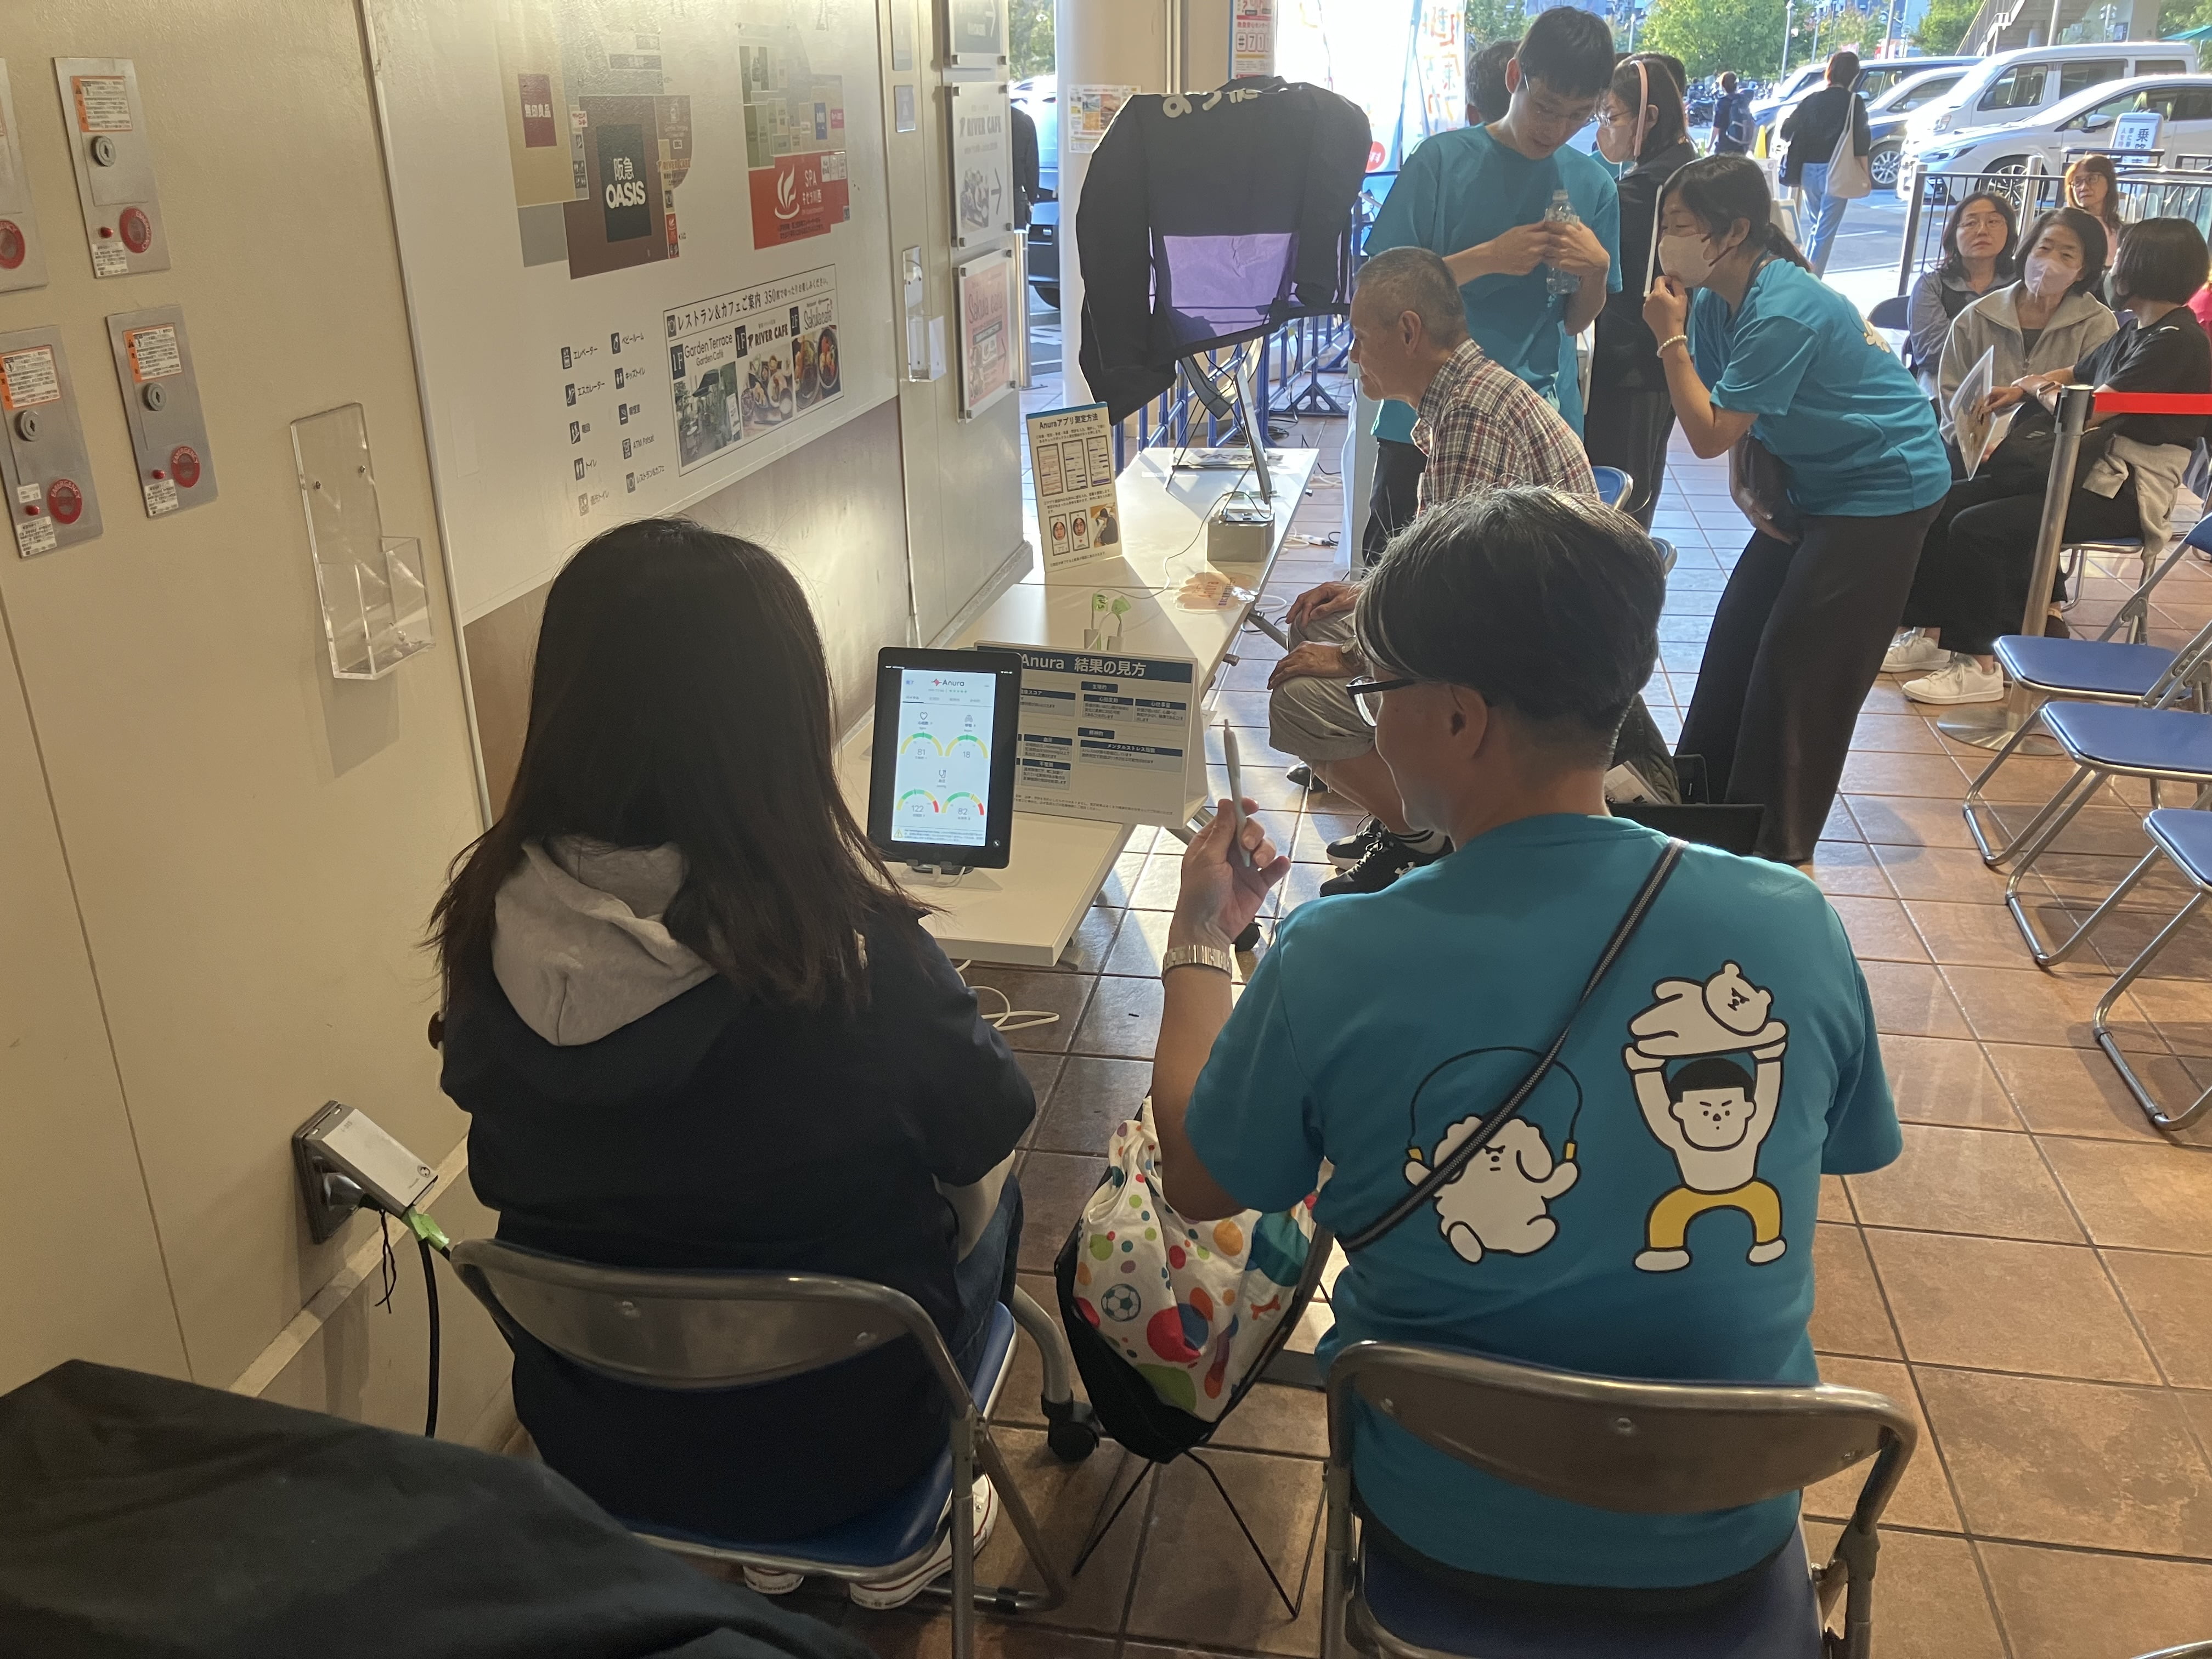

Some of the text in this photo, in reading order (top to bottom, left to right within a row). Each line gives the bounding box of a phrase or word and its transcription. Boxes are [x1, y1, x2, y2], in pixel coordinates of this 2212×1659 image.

[613, 156, 634, 181] 阪急
[804, 169, 817, 187] SPA
[606, 180, 646, 209] OASIS
[736, 331, 746, 351] 1F
[754, 330, 773, 347] RIVER
[774, 324, 788, 340] CAFE
[573, 346, 598, 359] エレベーター
[684, 333, 733, 359] Garden Terrace
[673, 352, 683, 371] 1F
[696, 354, 713, 366] Garden
[577, 381, 605, 396] エスカレーター
[585, 459, 597, 470] トイレ
[50, 480, 81, 499] EMERGENCY
[1022, 653, 1147, 676] Anura 結果の見方
